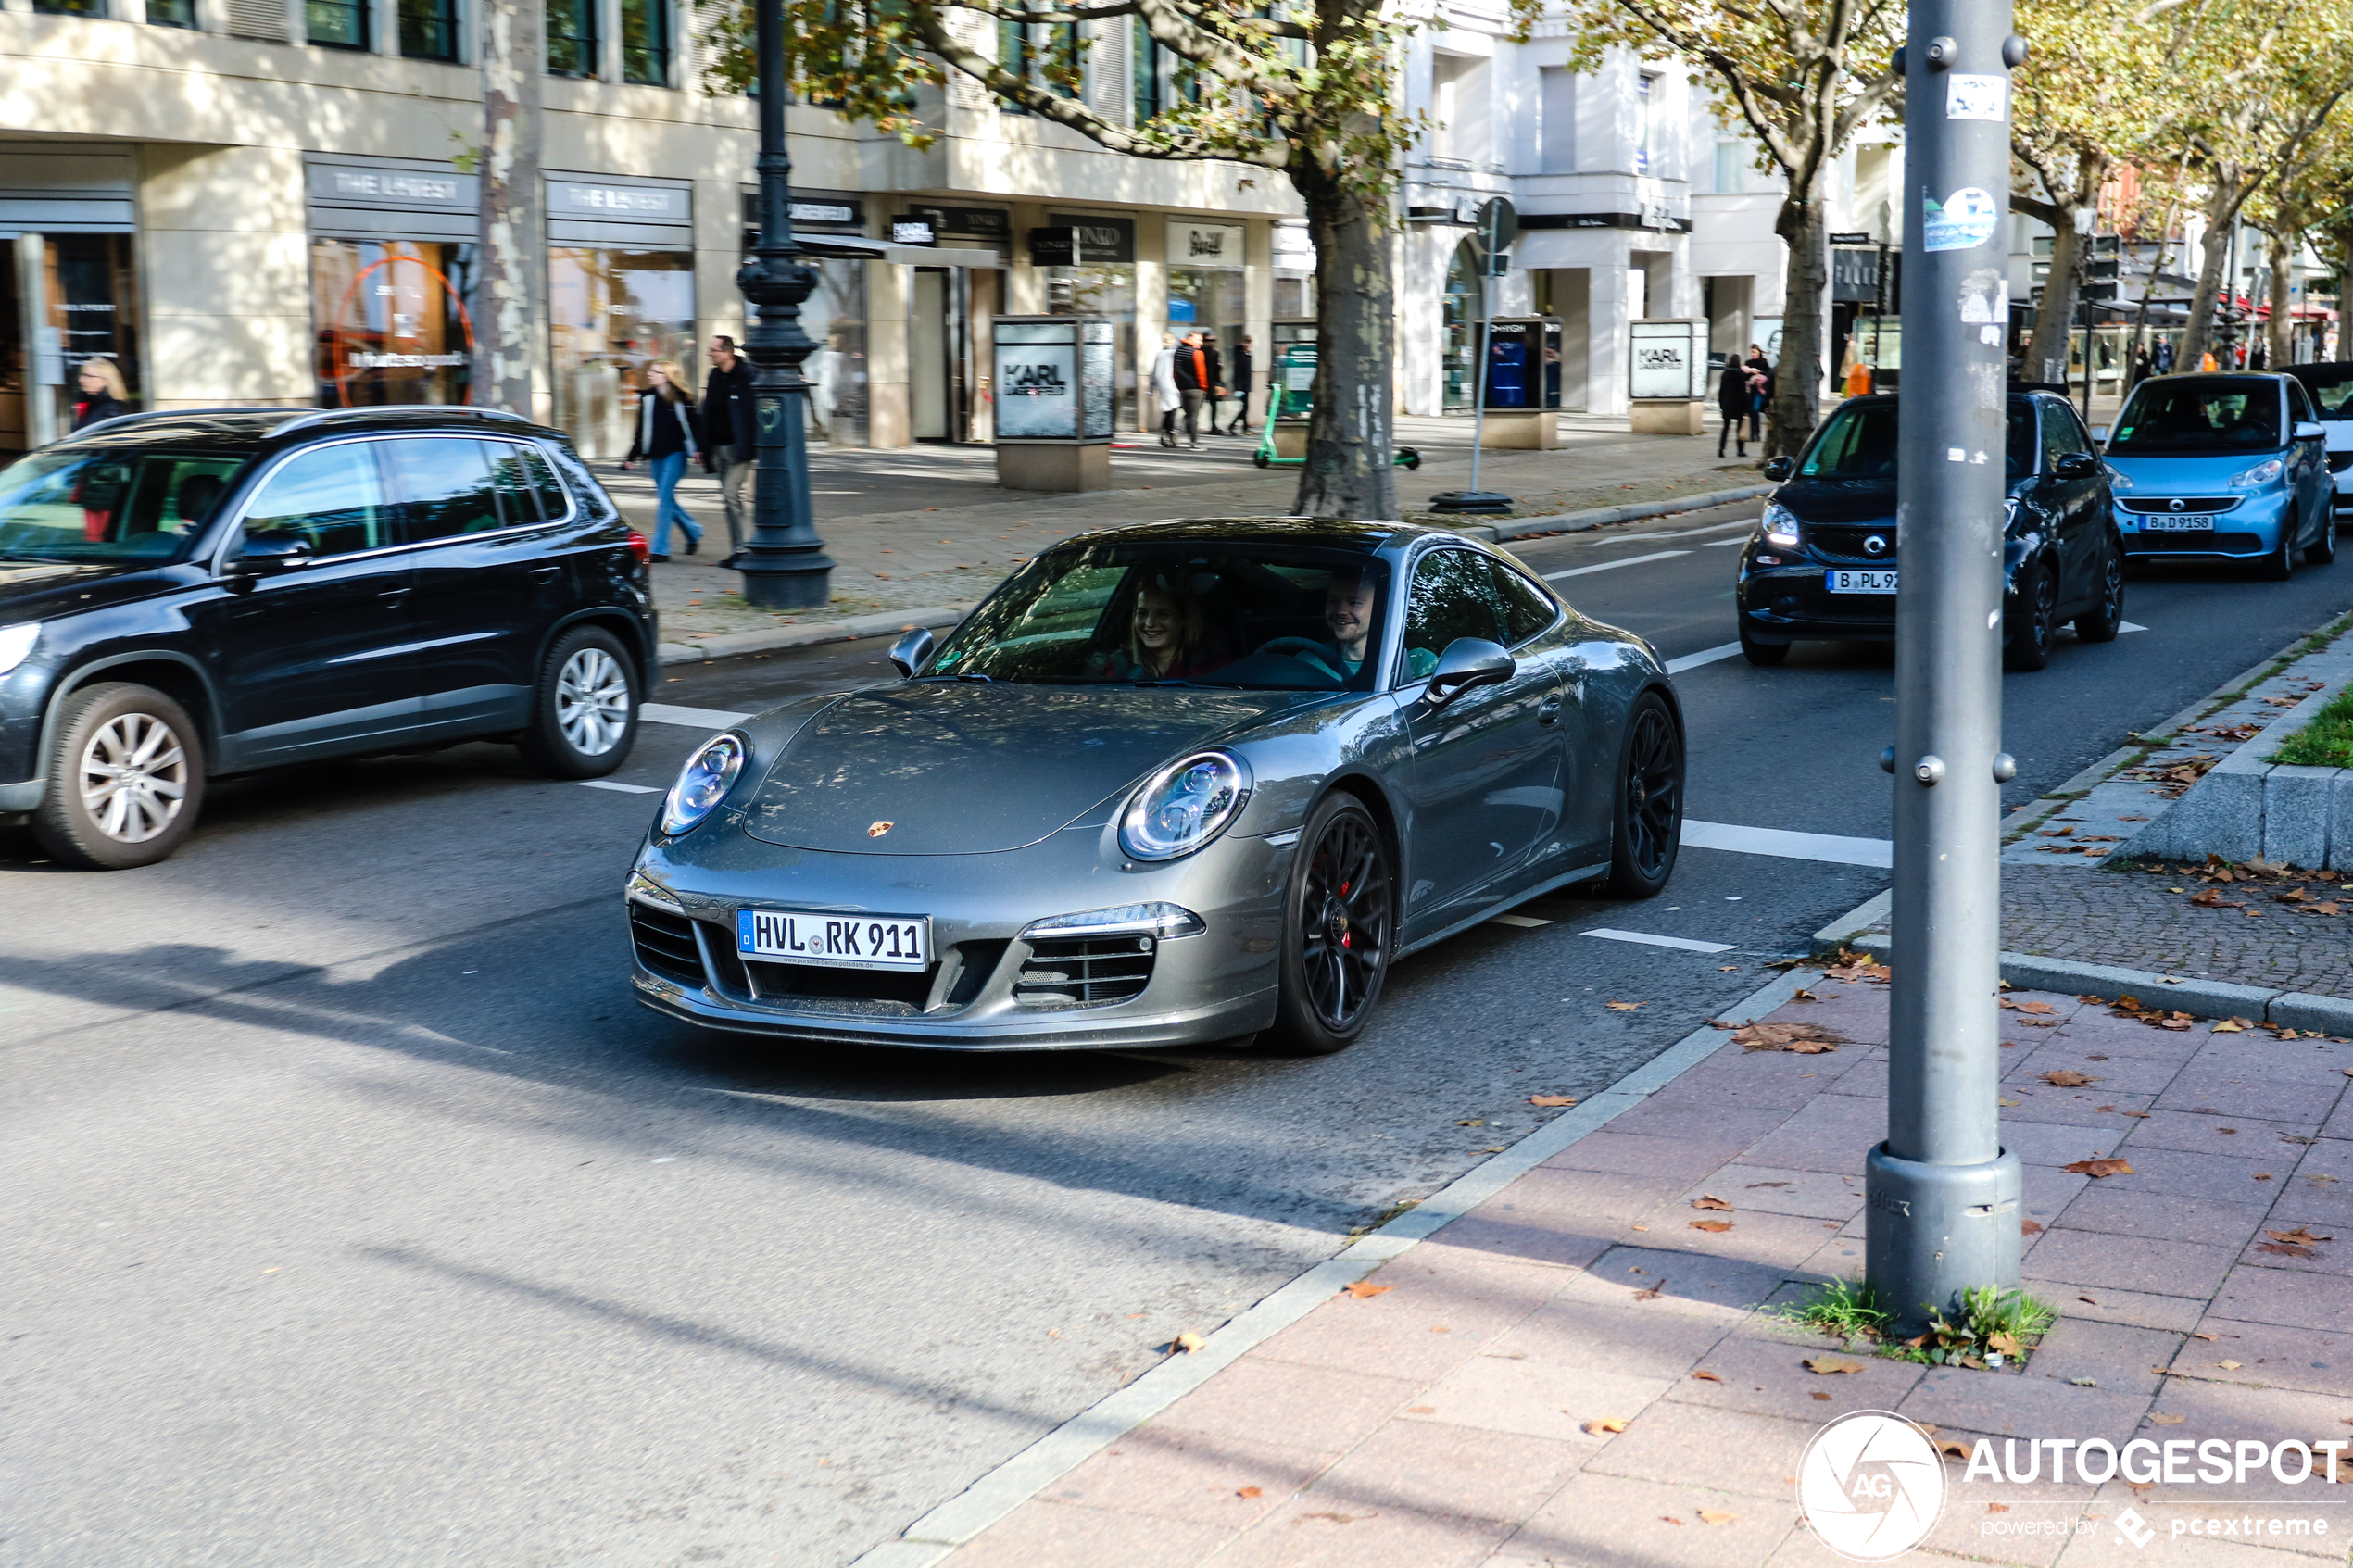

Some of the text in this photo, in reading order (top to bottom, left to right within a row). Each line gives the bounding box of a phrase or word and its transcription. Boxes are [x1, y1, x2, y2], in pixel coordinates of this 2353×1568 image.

[1638, 348, 1682, 362] KARL
[1003, 364, 1066, 385] KARL
[2151, 517, 2208, 528] B D 9158
[1841, 573, 1850, 588] B
[1861, 573, 1881, 588] PL
[743, 935, 750, 945] D
[756, 915, 921, 959] HVL RK 911
[784, 957, 874, 969] www.porsche-berlin-potsdam.de
